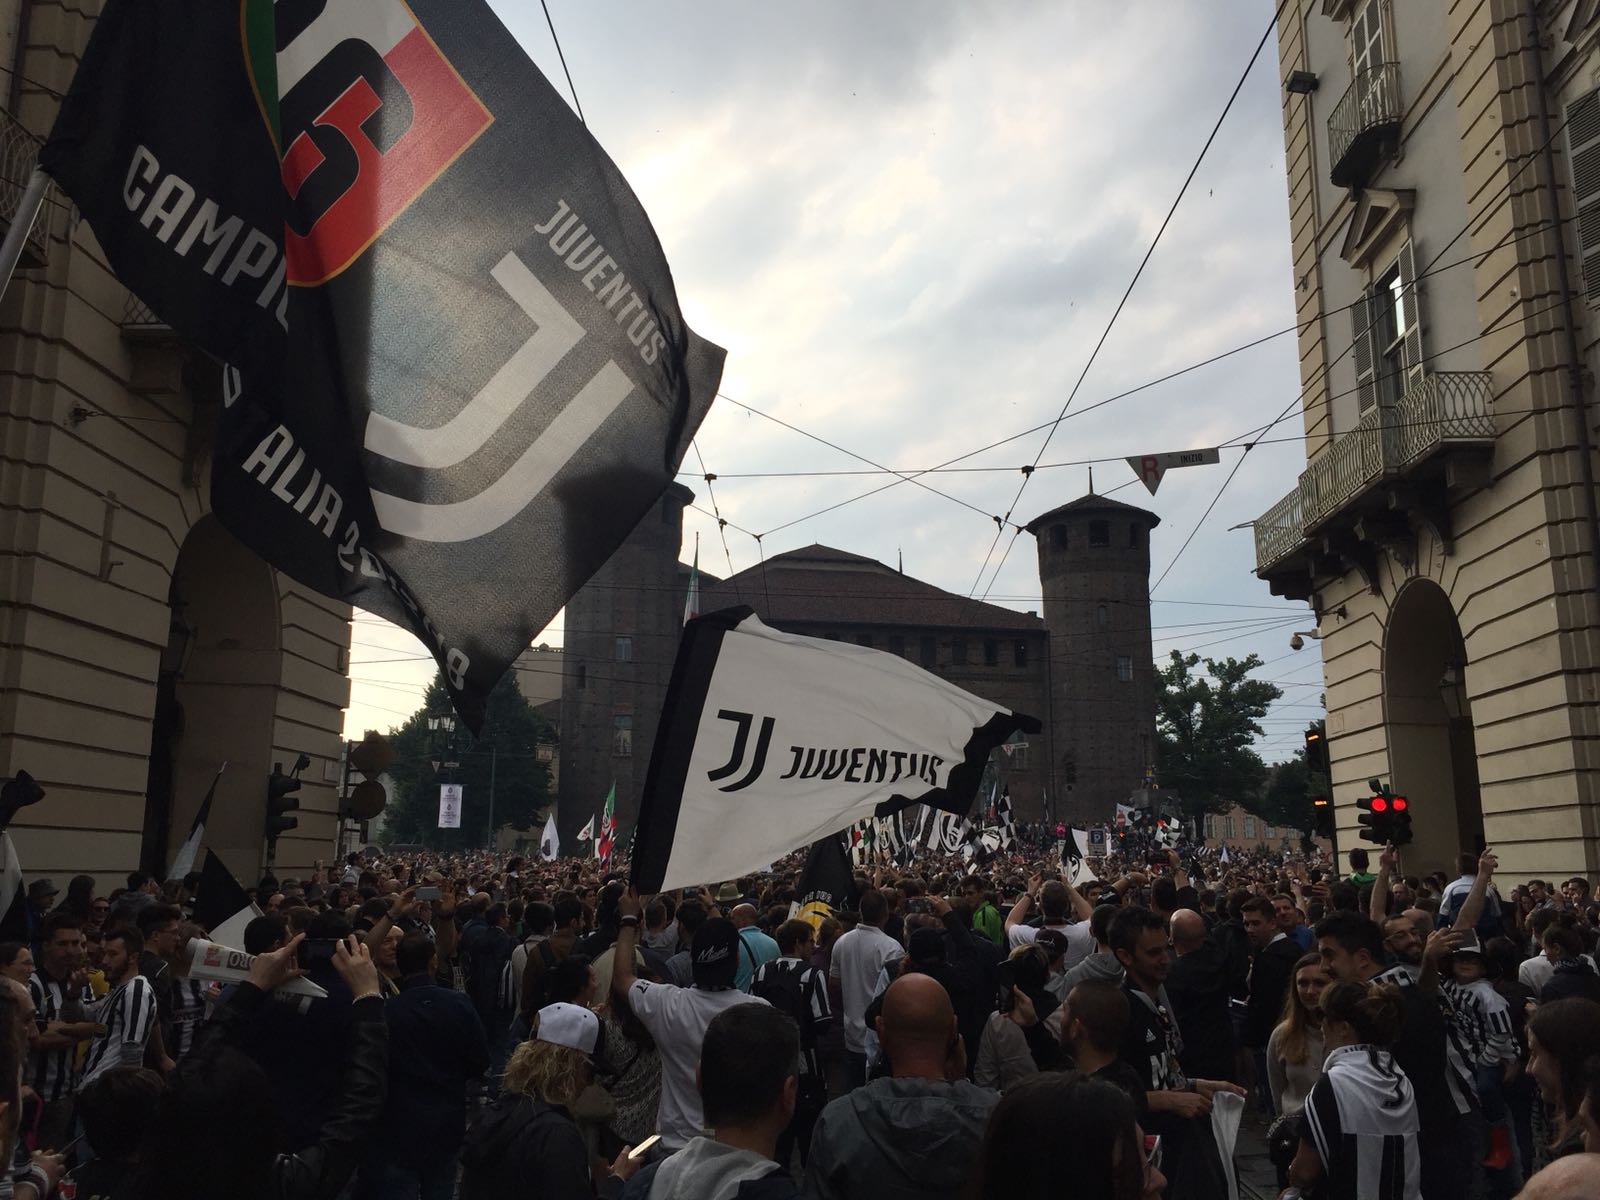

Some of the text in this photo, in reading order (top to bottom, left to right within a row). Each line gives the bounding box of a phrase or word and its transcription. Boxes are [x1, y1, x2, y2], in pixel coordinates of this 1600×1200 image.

[534, 199, 667, 366] JUVENTUS
[1140, 453, 1203, 482] R INIZIO
